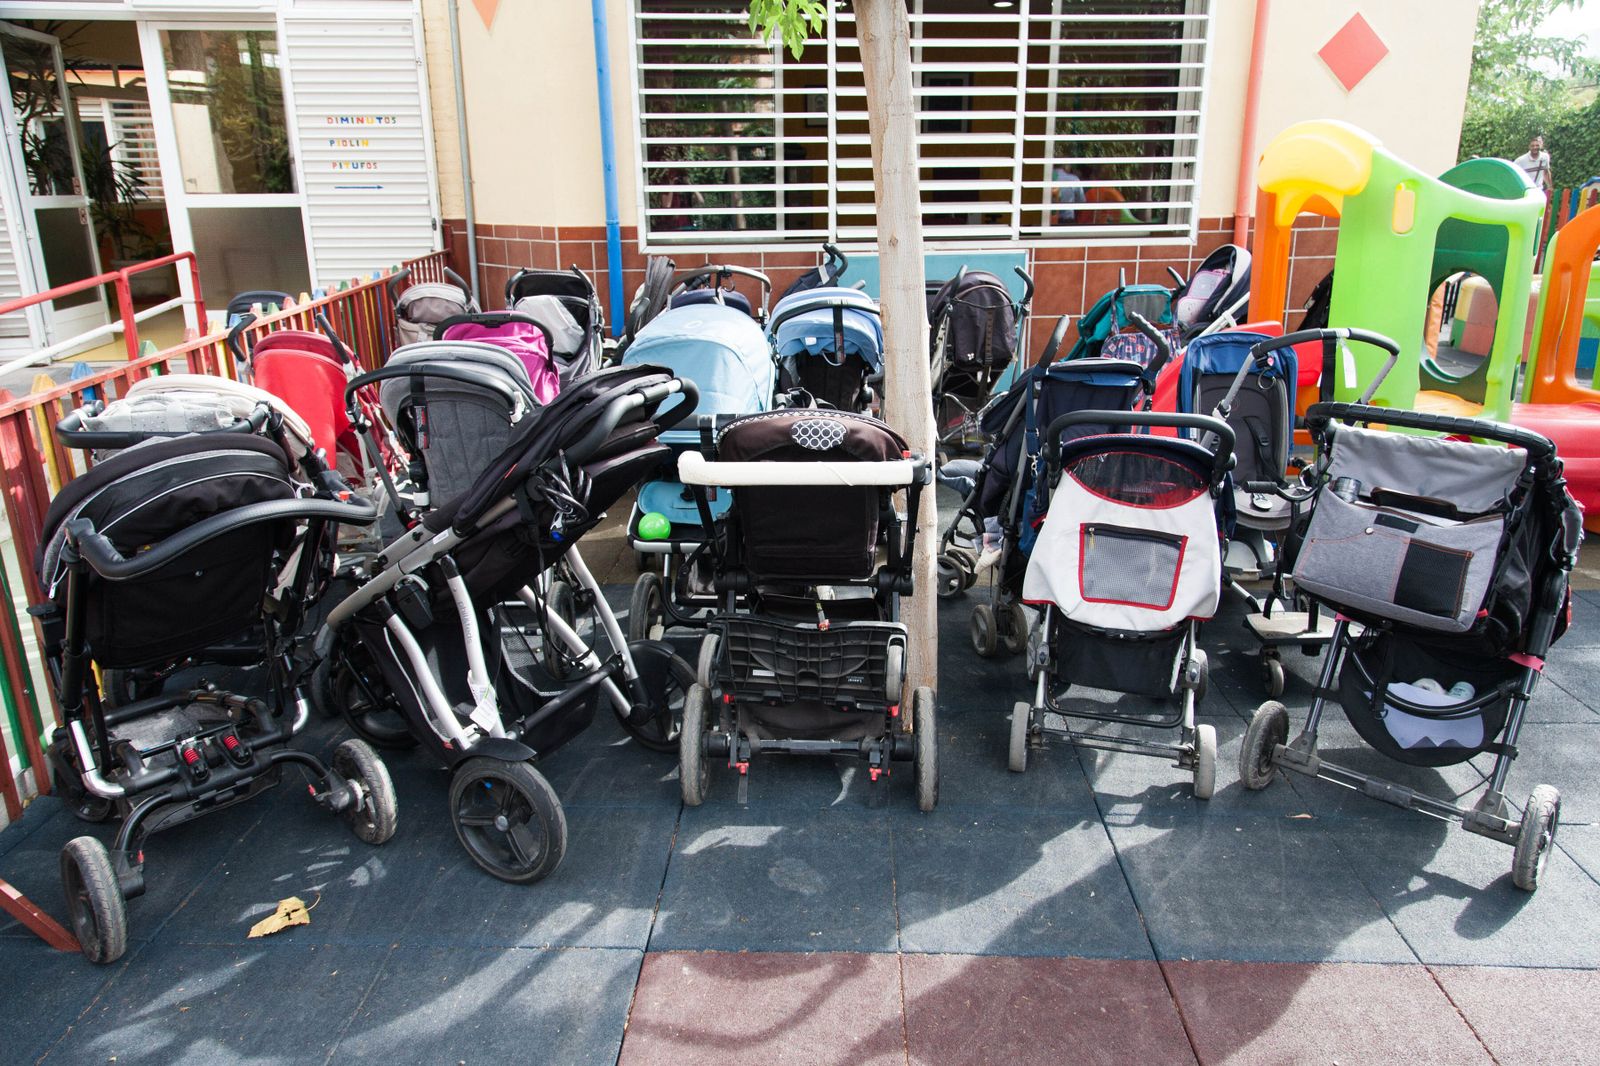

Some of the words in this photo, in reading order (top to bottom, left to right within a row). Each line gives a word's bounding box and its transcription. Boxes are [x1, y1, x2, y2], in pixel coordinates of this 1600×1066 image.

[327, 116, 397, 124] DIMINUTOS
[329, 139, 369, 147] PIOLIN
[332, 161, 378, 169] PITUFOS
